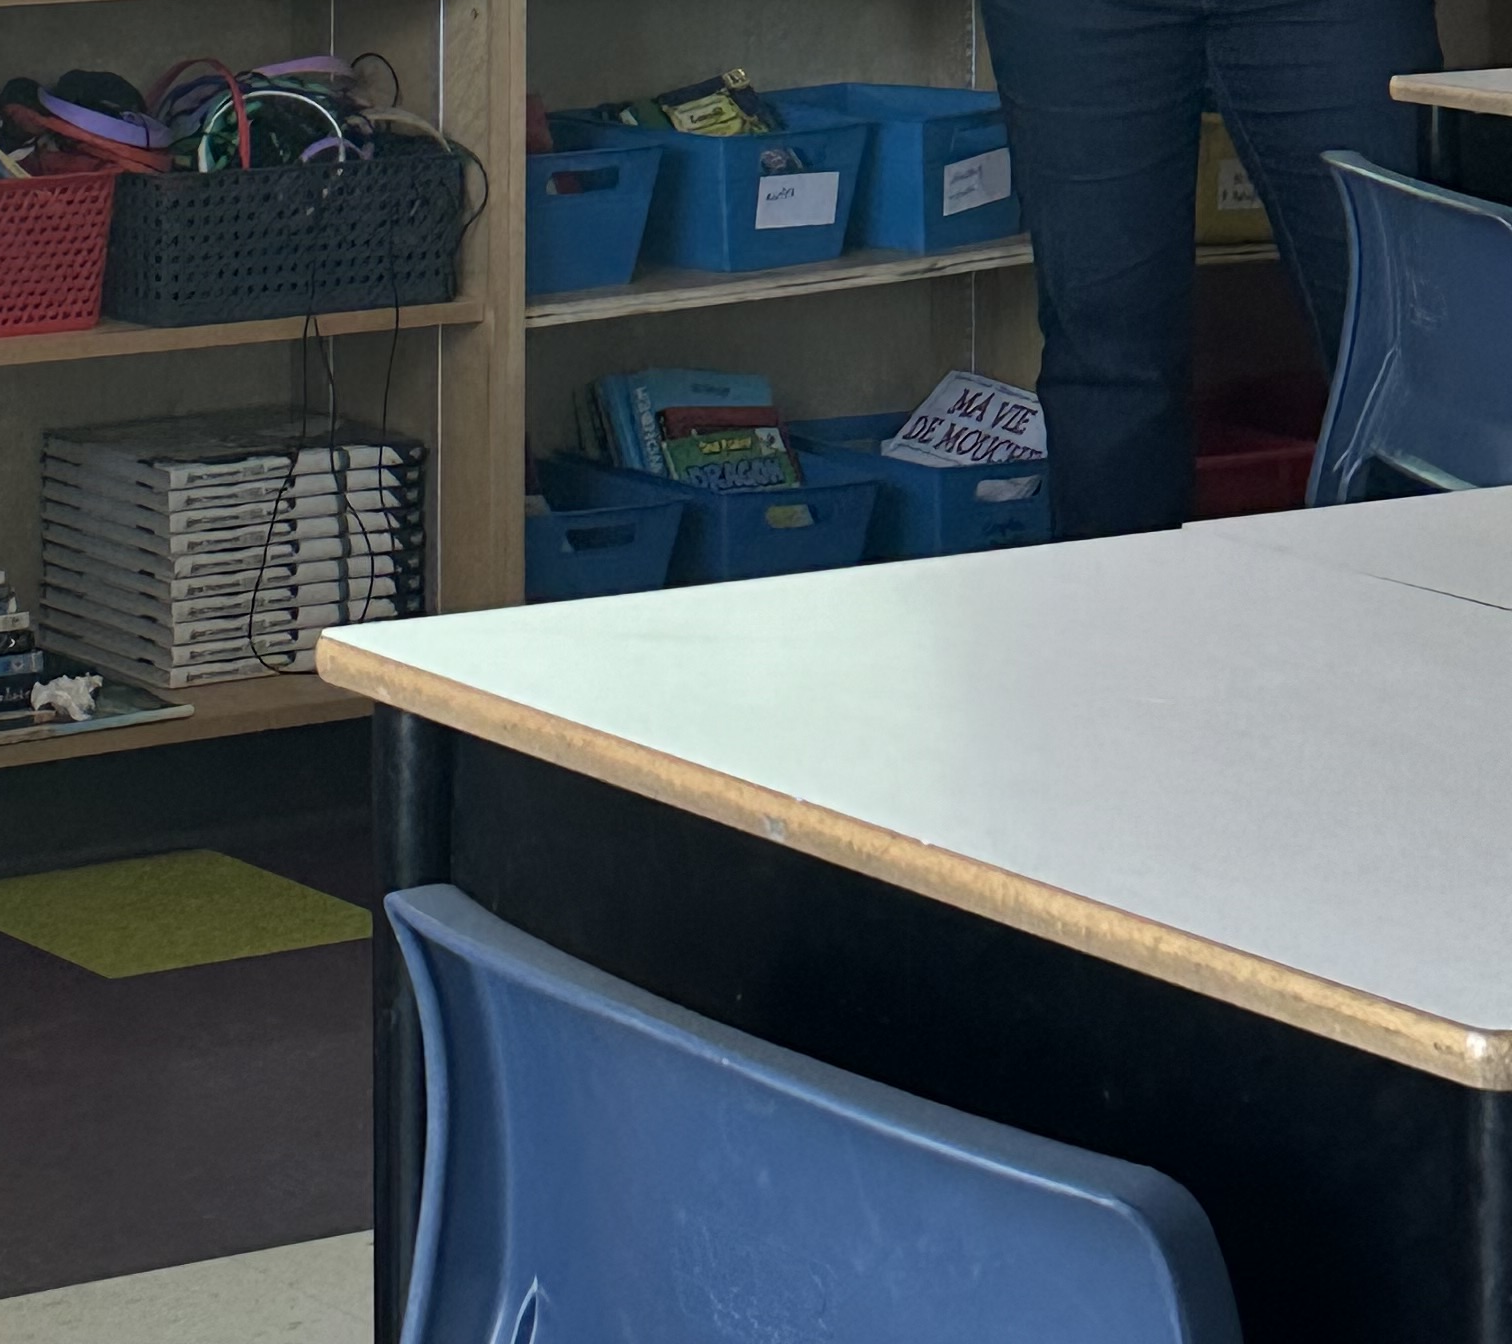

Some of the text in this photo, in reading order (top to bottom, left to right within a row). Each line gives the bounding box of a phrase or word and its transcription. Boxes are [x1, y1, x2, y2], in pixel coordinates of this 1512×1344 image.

[902, 415, 945, 444] DE
[947, 388, 1038, 435] MA VIE
